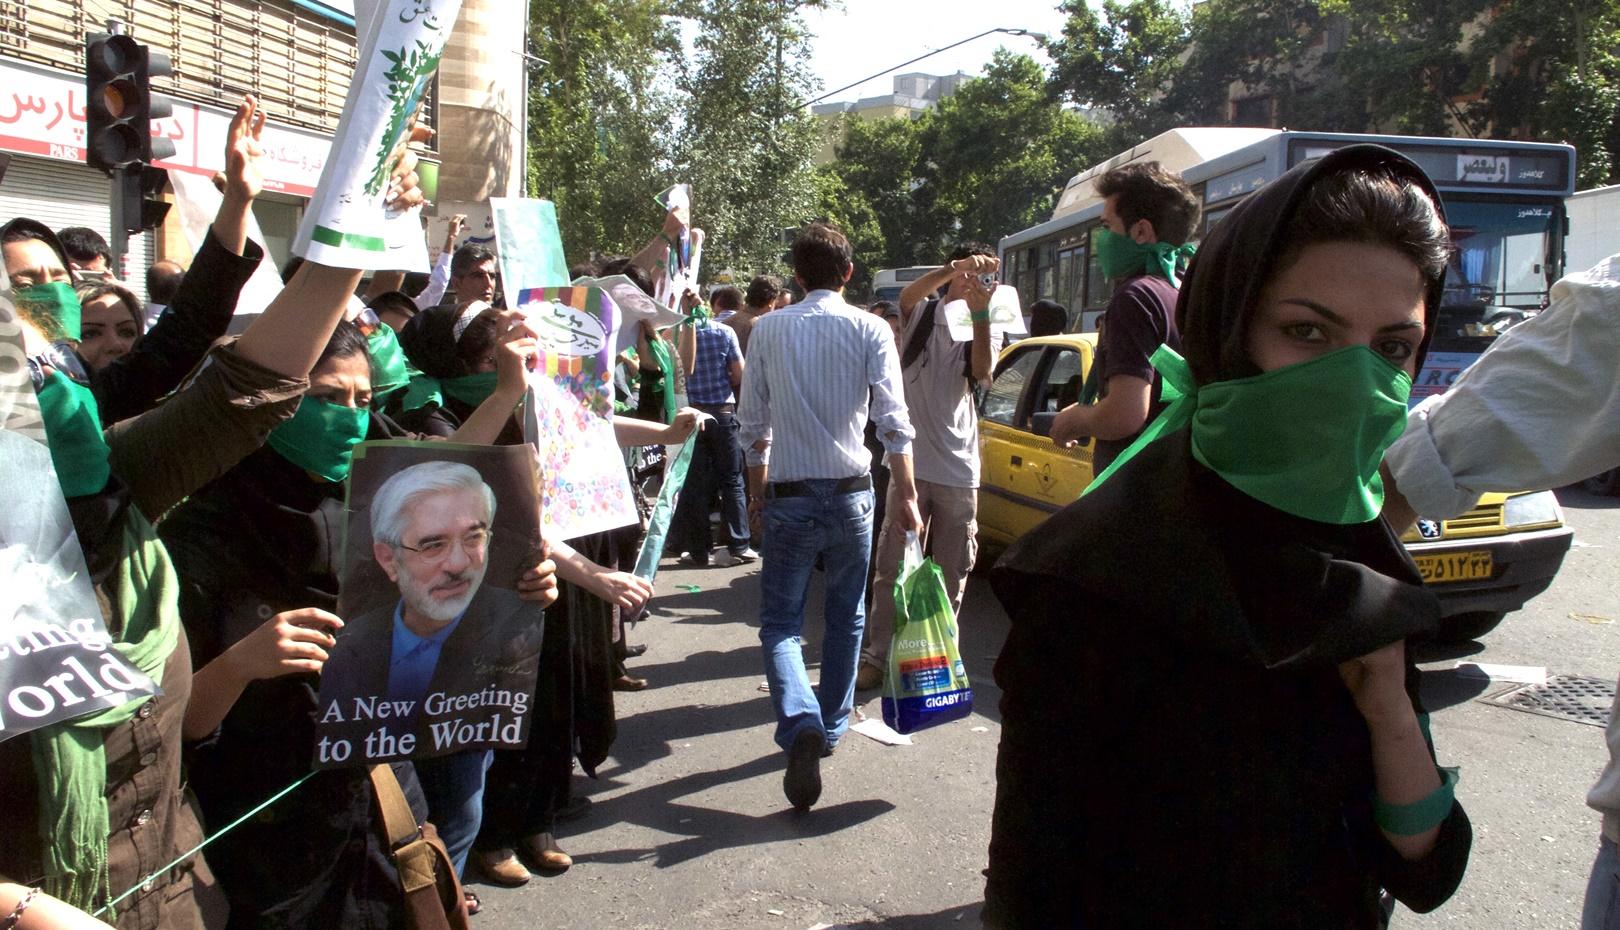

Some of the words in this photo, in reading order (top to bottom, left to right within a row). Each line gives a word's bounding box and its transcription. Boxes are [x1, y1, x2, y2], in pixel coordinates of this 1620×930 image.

[50, 144, 78, 160] PARS
[647, 452, 662, 466] the
[898, 639, 927, 650] More
[0, 653, 145, 722] orld
[320, 699, 345, 724] A
[353, 696, 416, 720] New
[424, 683, 530, 714] Greeting
[925, 691, 971, 708] GIGABYTE
[318, 736, 352, 763] to
[364, 726, 416, 759] the
[429, 713, 522, 751] World
